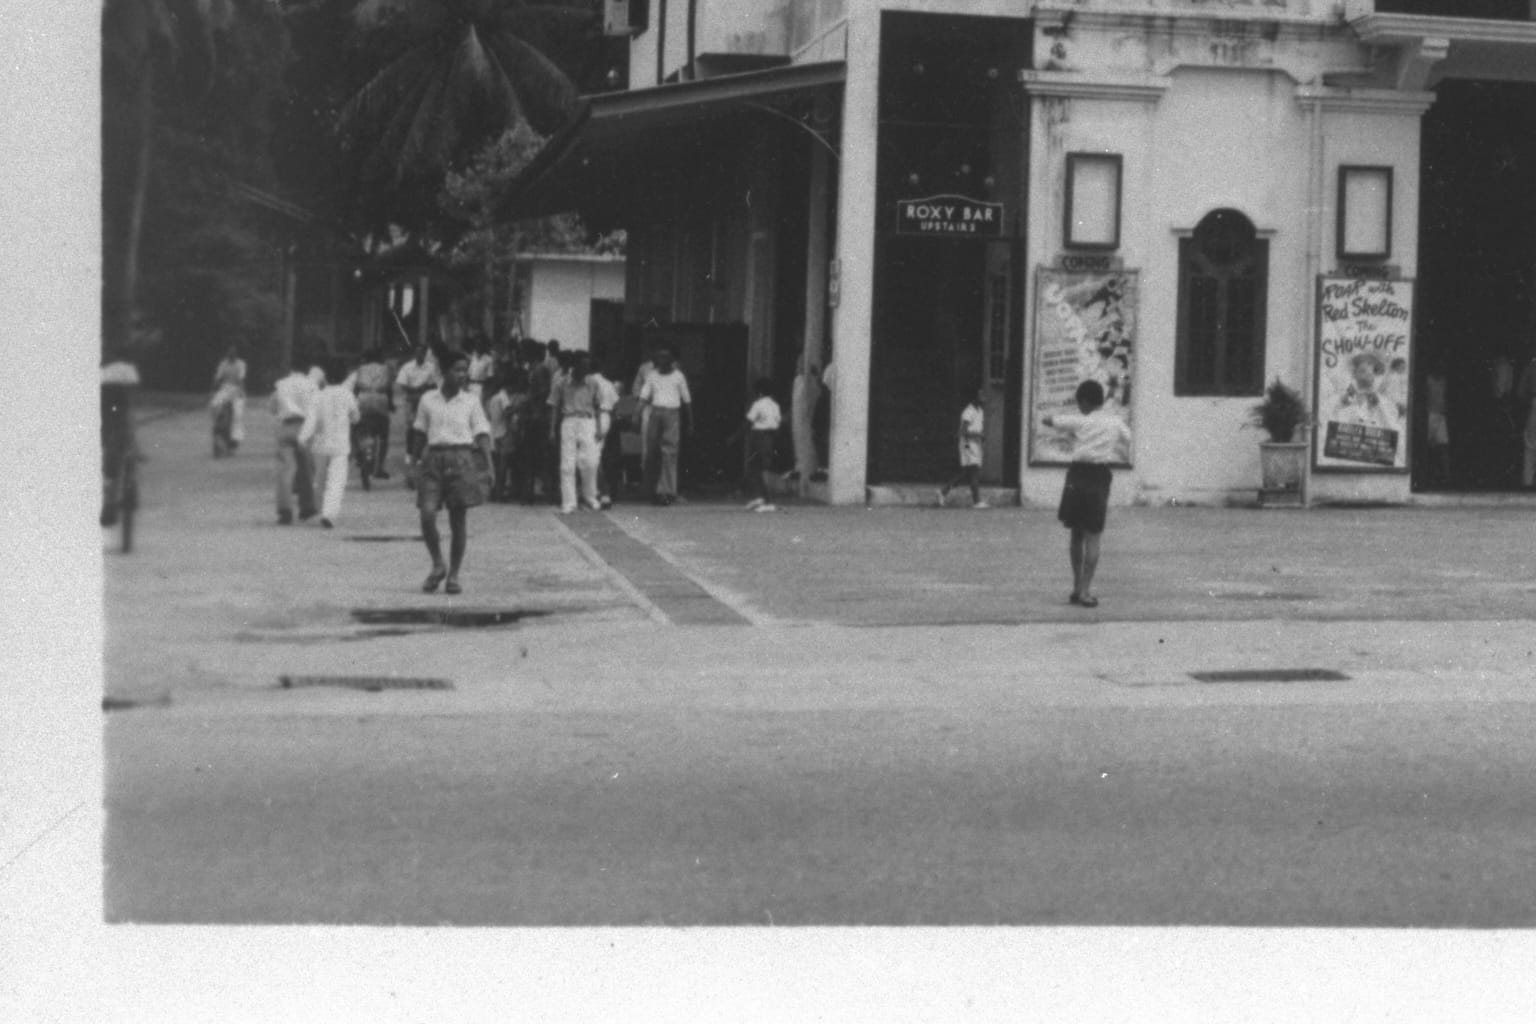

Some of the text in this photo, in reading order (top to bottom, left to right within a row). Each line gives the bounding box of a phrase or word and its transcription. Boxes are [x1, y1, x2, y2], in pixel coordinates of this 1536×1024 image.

[906, 204, 994, 222] ROXY BAR
[920, 220, 977, 233] UPSTAIRS
[1062, 255, 1111, 272] COMING
[1322, 296, 1409, 323] Red Skelton
[1355, 319, 1377, 333] The
[1322, 333, 1406, 369] SHOW-OFF
